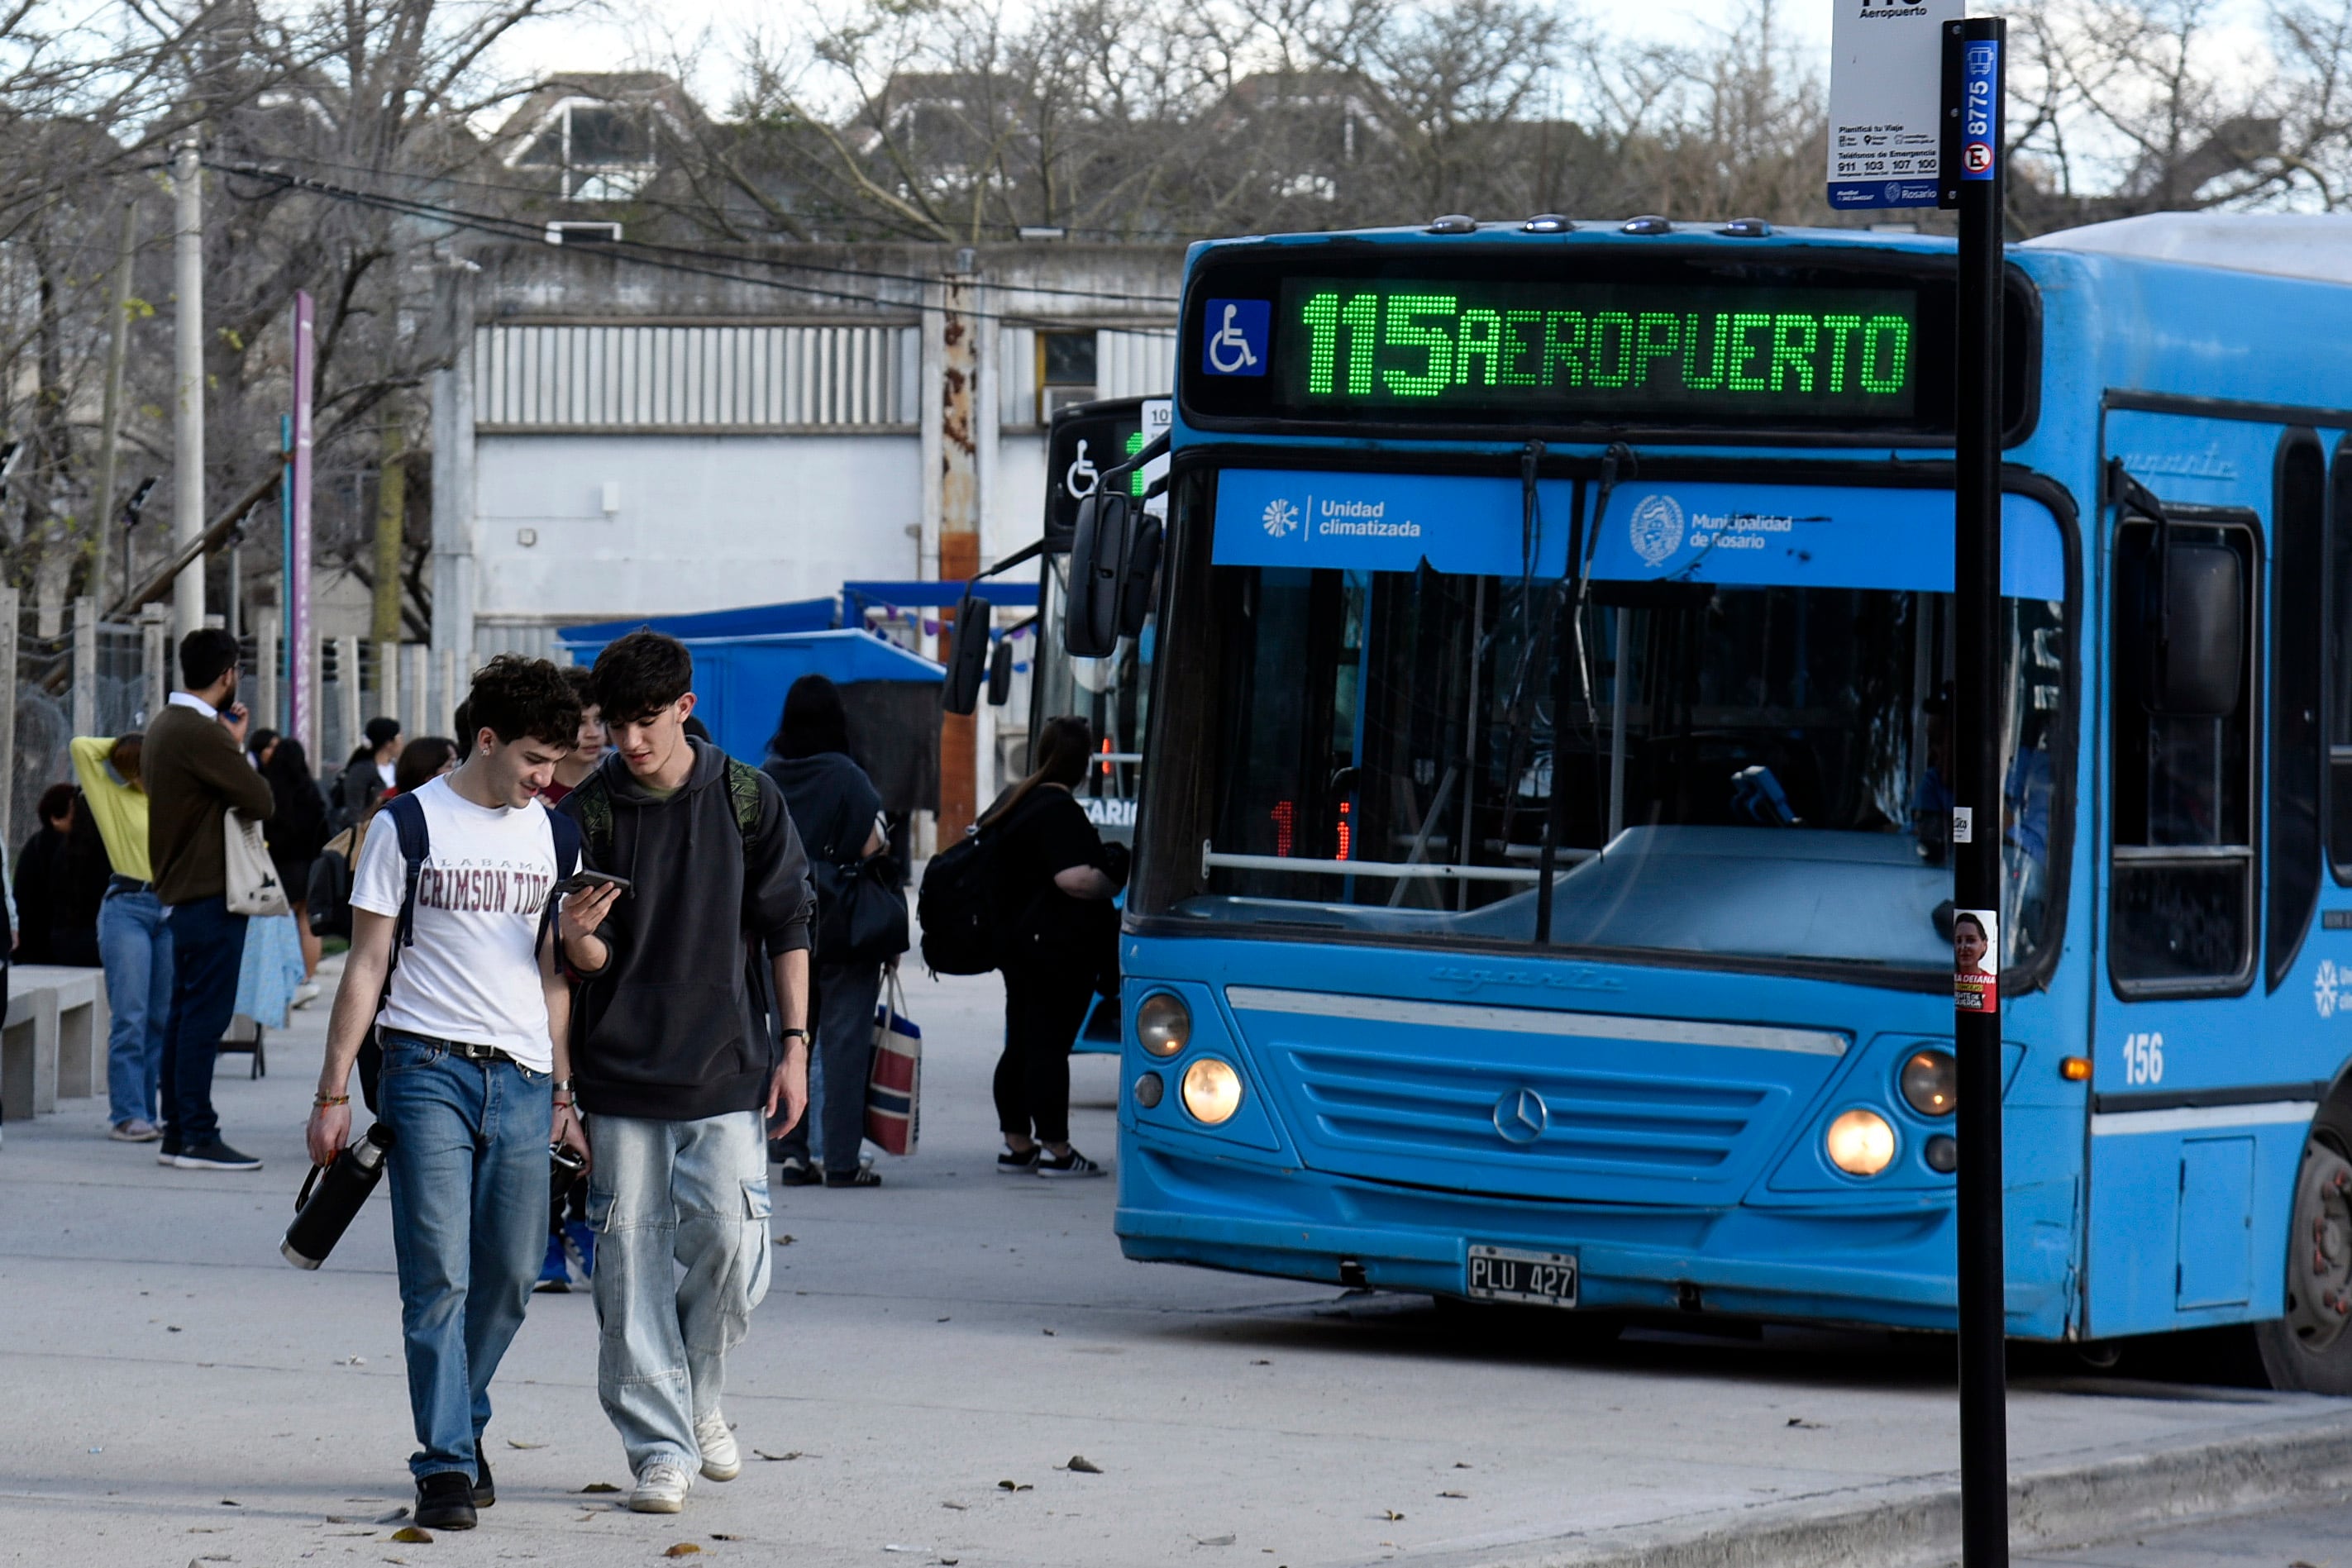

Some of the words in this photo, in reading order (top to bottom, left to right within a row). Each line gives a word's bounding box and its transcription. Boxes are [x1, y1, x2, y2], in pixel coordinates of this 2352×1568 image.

[1858, 7, 1927, 19] Aeropuerto
[1968, 80, 1989, 136] 8775
[1884, 124, 1904, 132] Viaje
[1838, 162, 1856, 171] 911
[1864, 161, 1884, 170] 103
[1892, 160, 1911, 169] 107
[1917, 159, 1937, 169] 100
[1901, 188, 1937, 199] Rosario
[1302, 293, 1457, 397] 115
[1455, 309, 1910, 395] AEROPUERTO
[1152, 408, 1171, 422] 10
[1320, 499, 1385, 518] Unidad
[1319, 520, 1421, 538] climatizada
[1691, 512, 1792, 535] Municipalidad
[1690, 532, 1710, 547] de
[1711, 533, 1765, 550] Rosario
[423, 858, 549, 871] ALABAMA
[419, 868, 508, 913] CRIMSON
[2123, 1032, 2164, 1084] 156
[1472, 1259, 1515, 1289] PLU
[1529, 1265, 1572, 1297] 427
